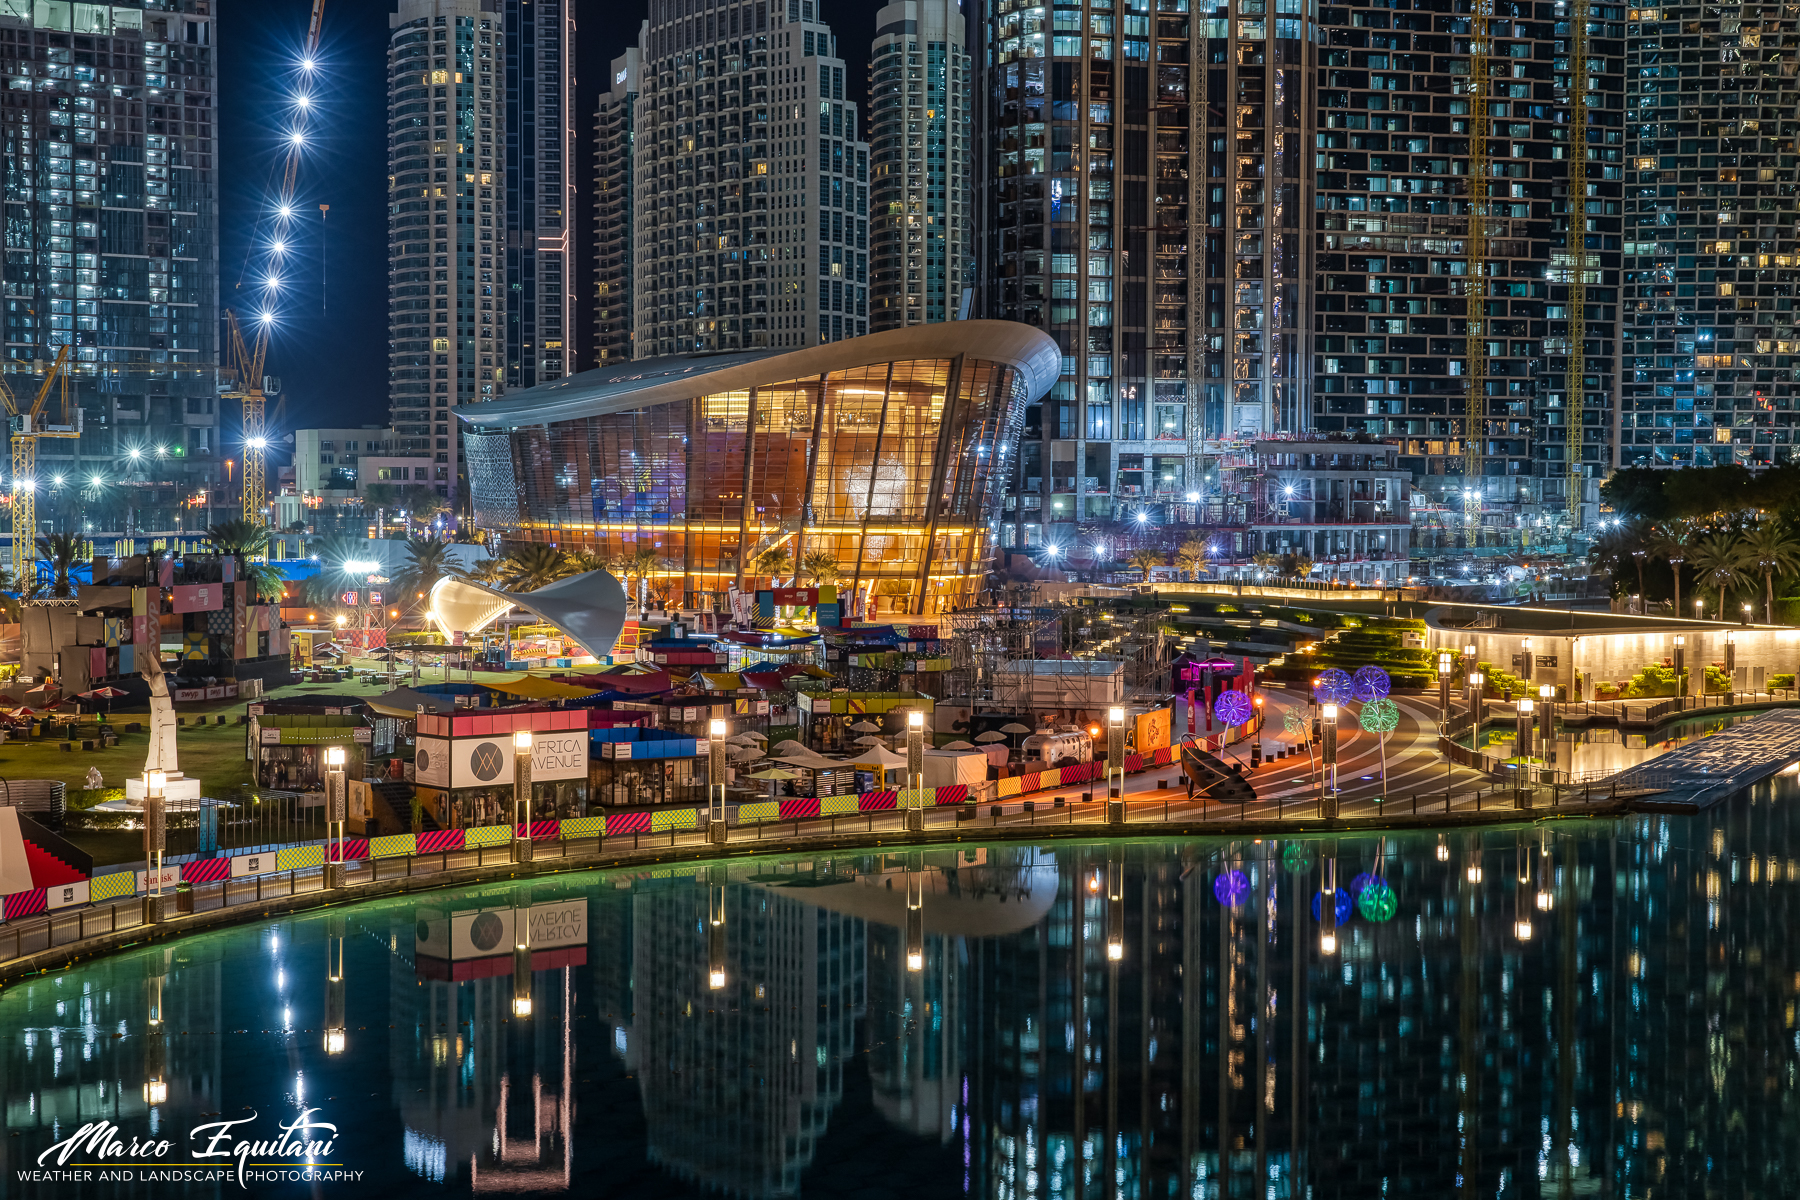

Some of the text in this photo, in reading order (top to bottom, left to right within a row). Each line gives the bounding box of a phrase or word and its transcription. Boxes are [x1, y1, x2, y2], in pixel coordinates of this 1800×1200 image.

[236, 594, 246, 646] swyp
[181, 691, 199, 699] swyp
[530, 739, 582, 754] AFRICA
[531, 754, 582, 770] AVENUE
[144, 874, 173, 885] Sanisk
